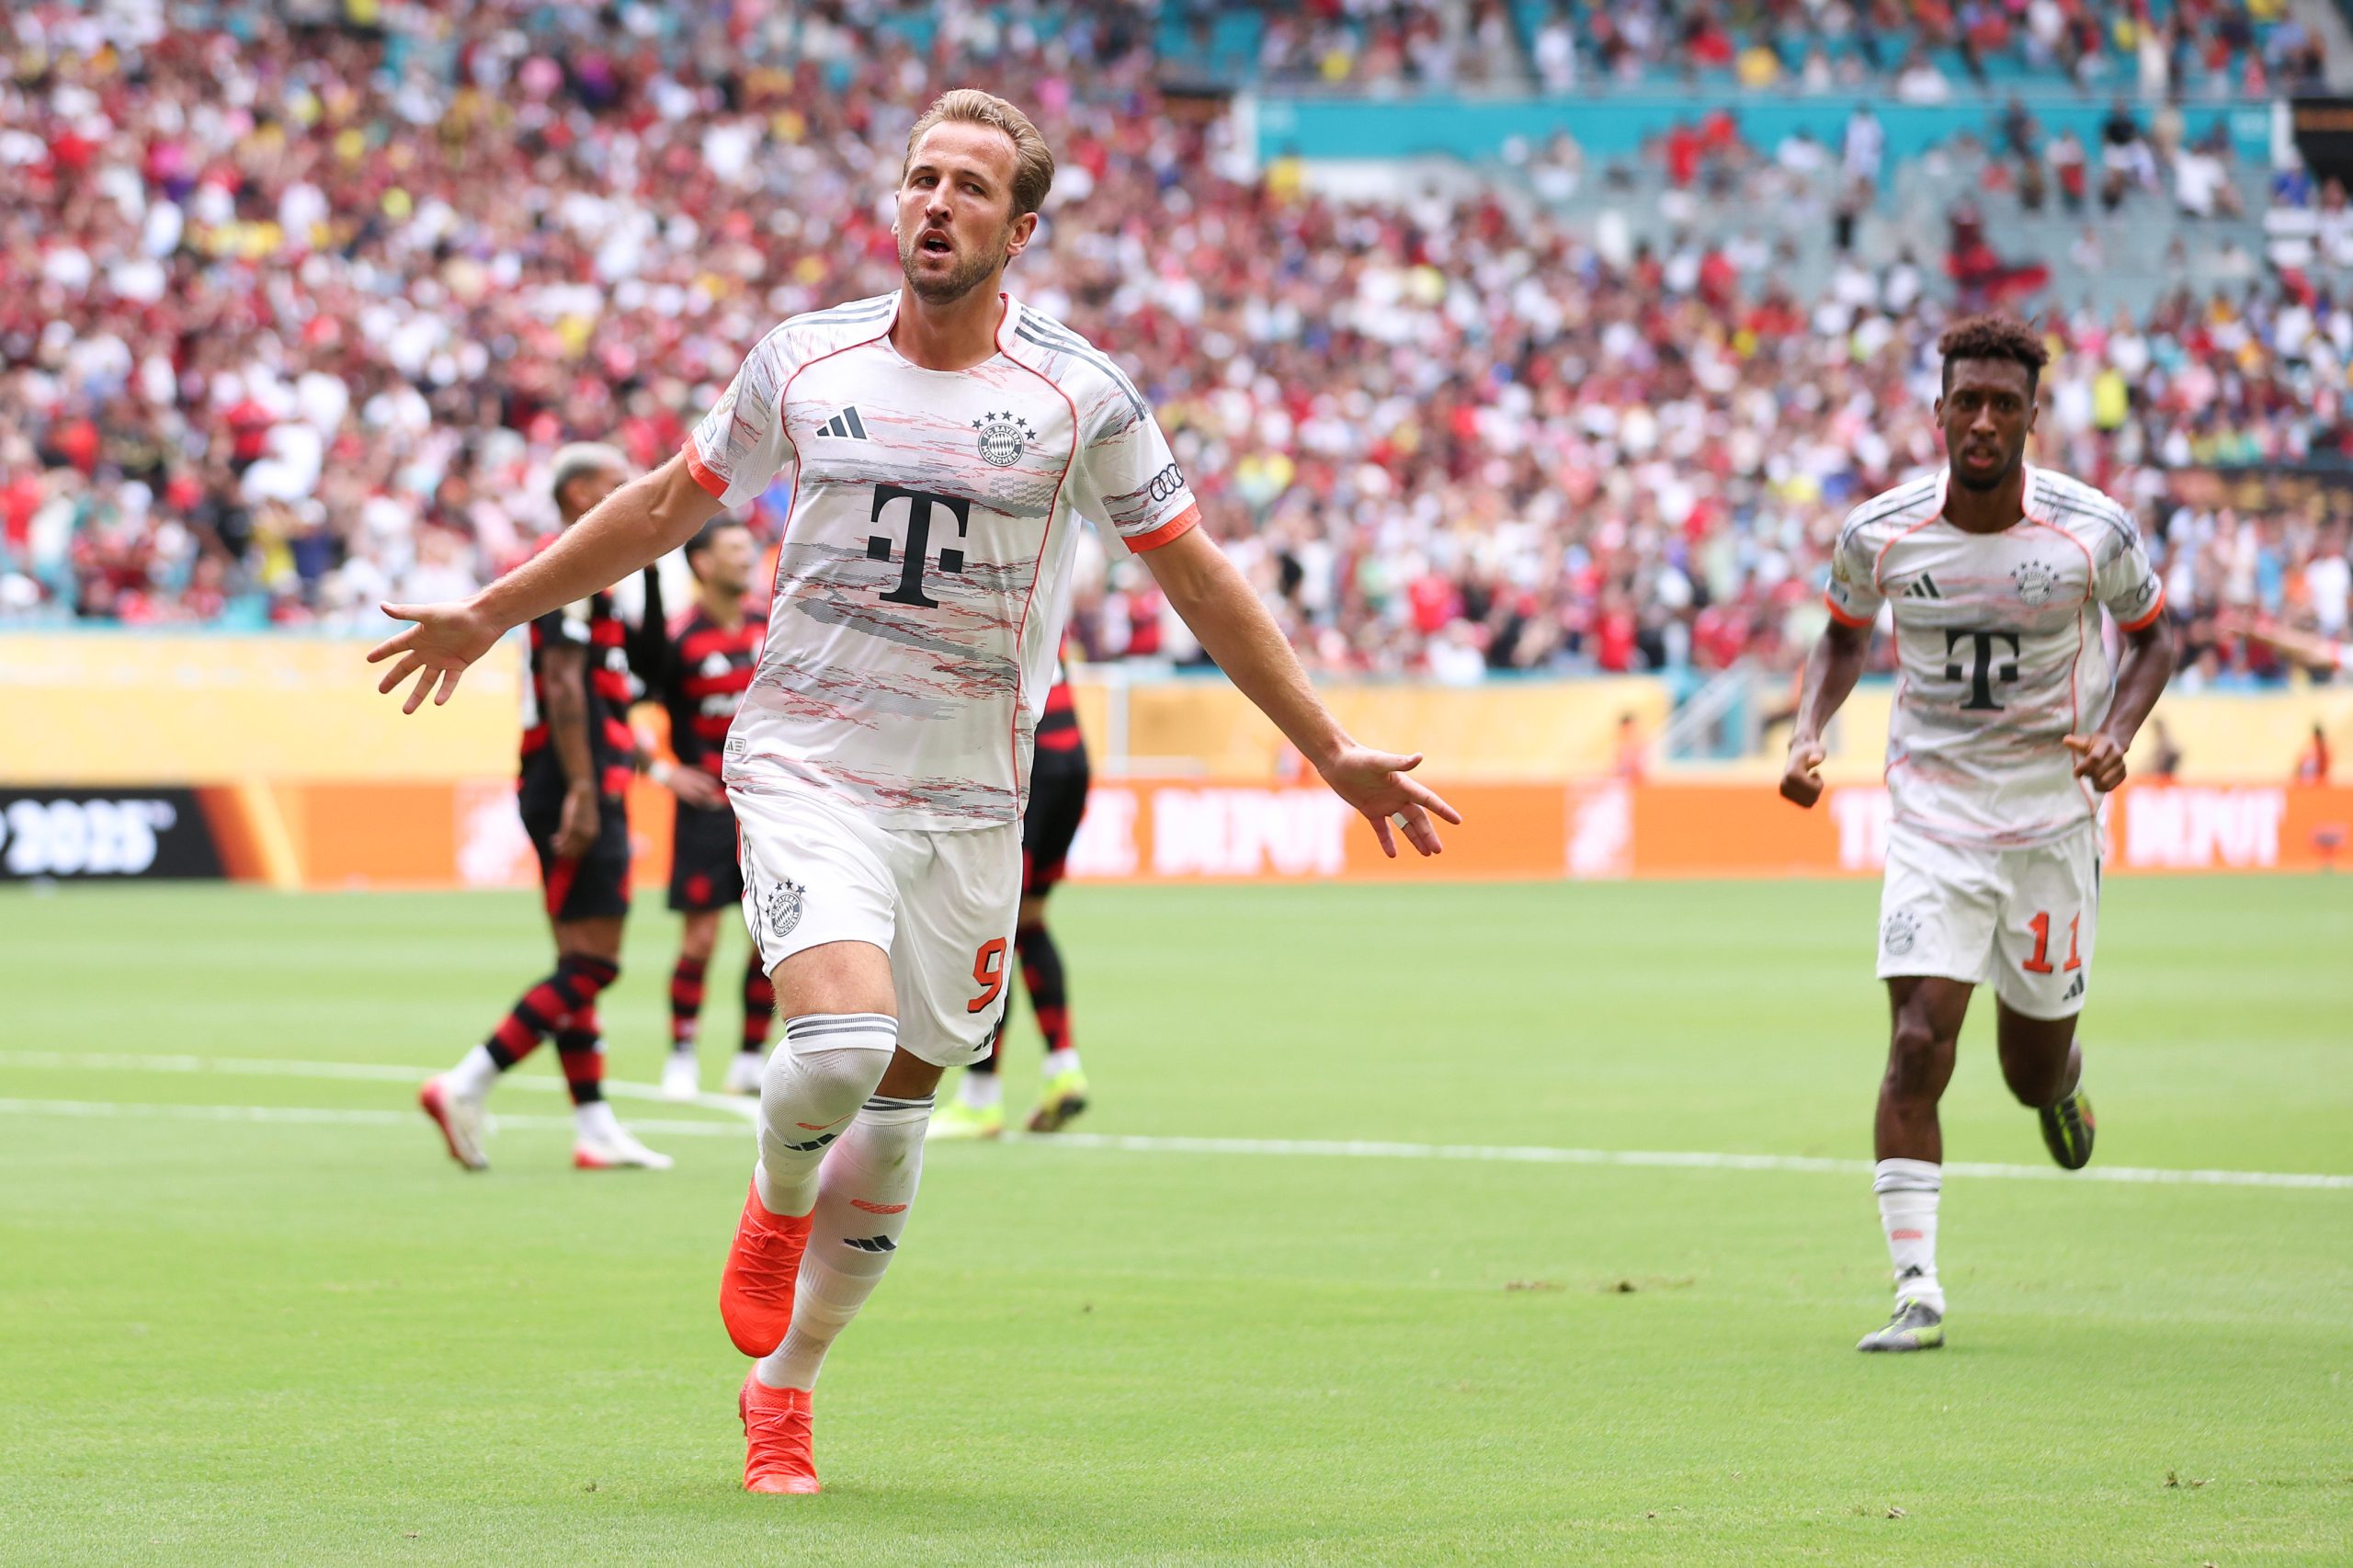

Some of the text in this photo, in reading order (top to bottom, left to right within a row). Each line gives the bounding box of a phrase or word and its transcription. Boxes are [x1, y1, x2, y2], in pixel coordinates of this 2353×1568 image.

[983, 426, 1021, 445] FC BAYERN
[867, 483, 971, 608] T
[1945, 628, 2019, 711] T
[967, 937, 1007, 1014] 9
[2022, 911, 2082, 973] 11
